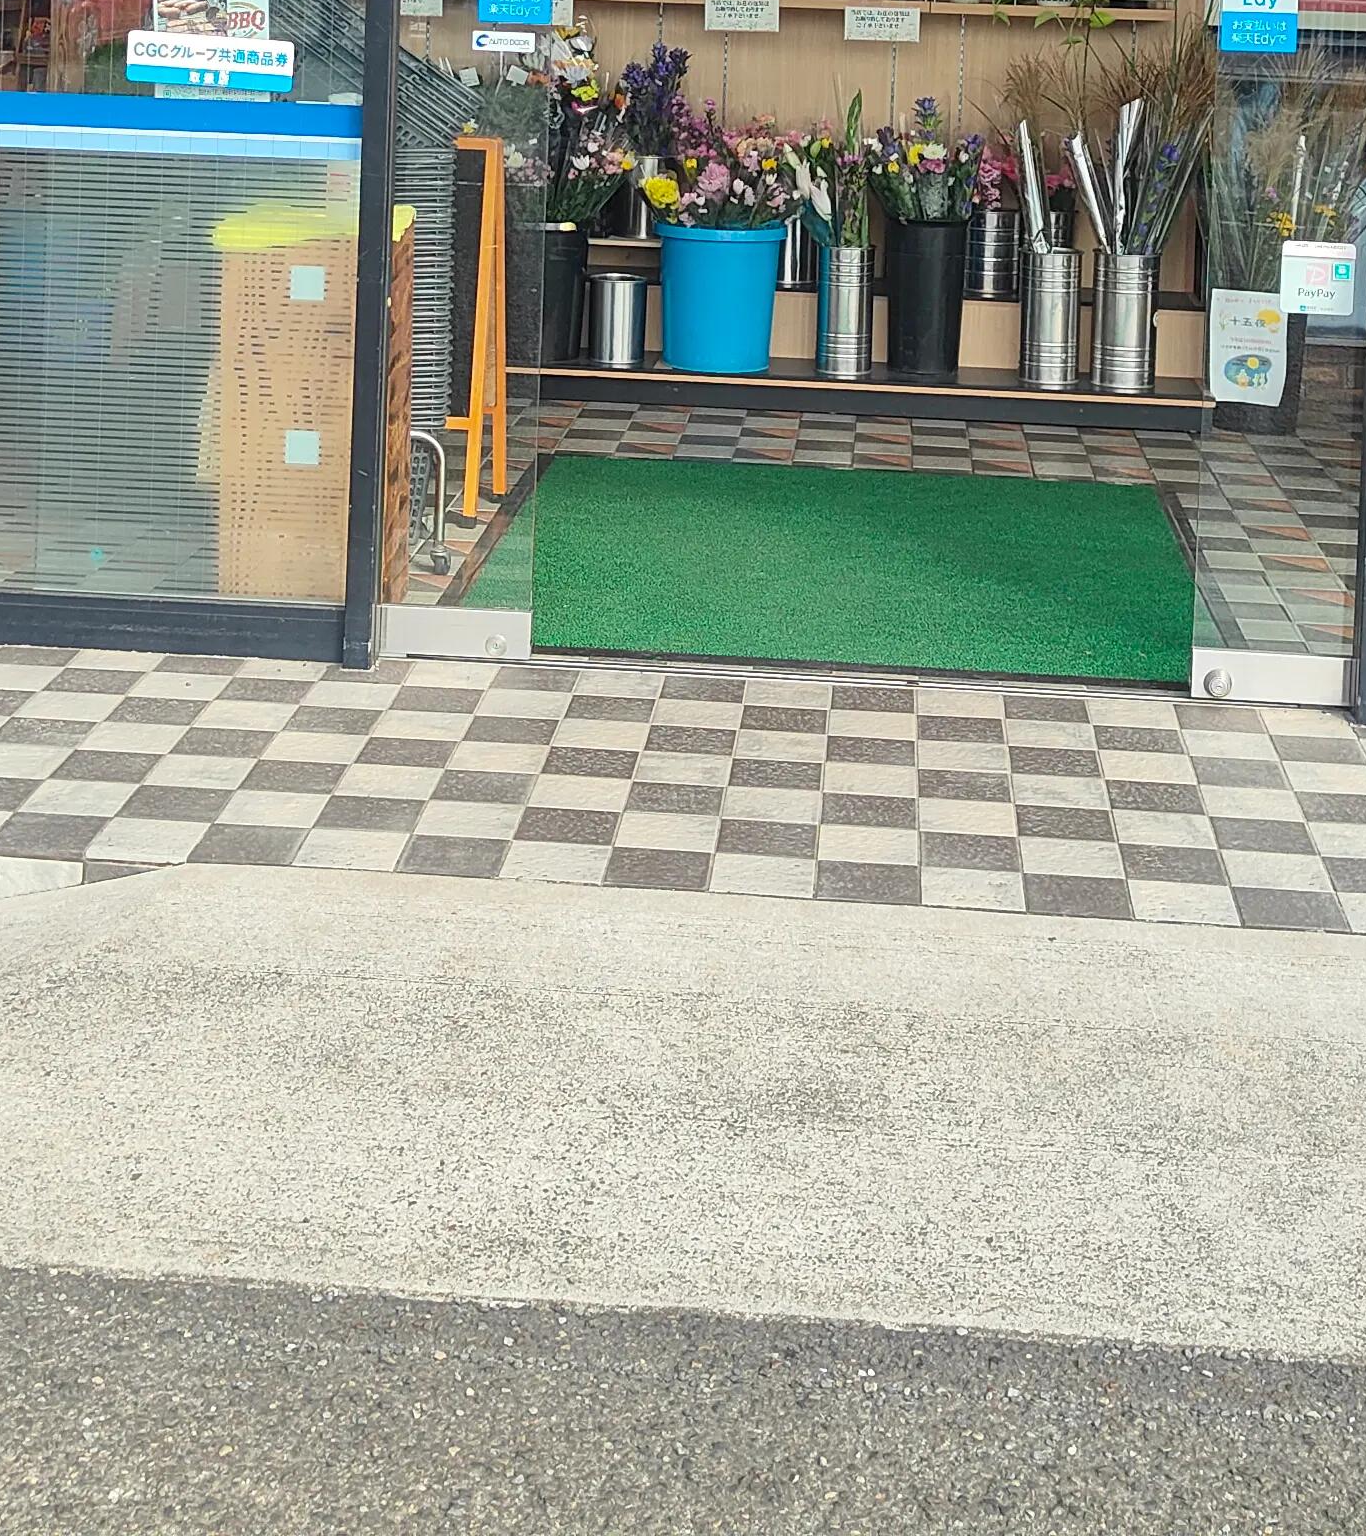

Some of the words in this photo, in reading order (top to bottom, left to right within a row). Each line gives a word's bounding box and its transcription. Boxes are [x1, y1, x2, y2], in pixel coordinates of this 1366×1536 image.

[488, 3, 541, 18] 楽天Edyで
[226, 9, 267, 32] BBQ
[1231, 19, 1288, 33] お支払いは
[489, 36, 508, 46] AUTO
[509, 37, 530, 47] DOOR
[1231, 32, 1288, 47] 楽天Edyで
[133, 41, 289, 68] CGCグループ共通商品券
[1297, 287, 1337, 300] PayPay
[1229, 315, 1268, 329] 十五夜
